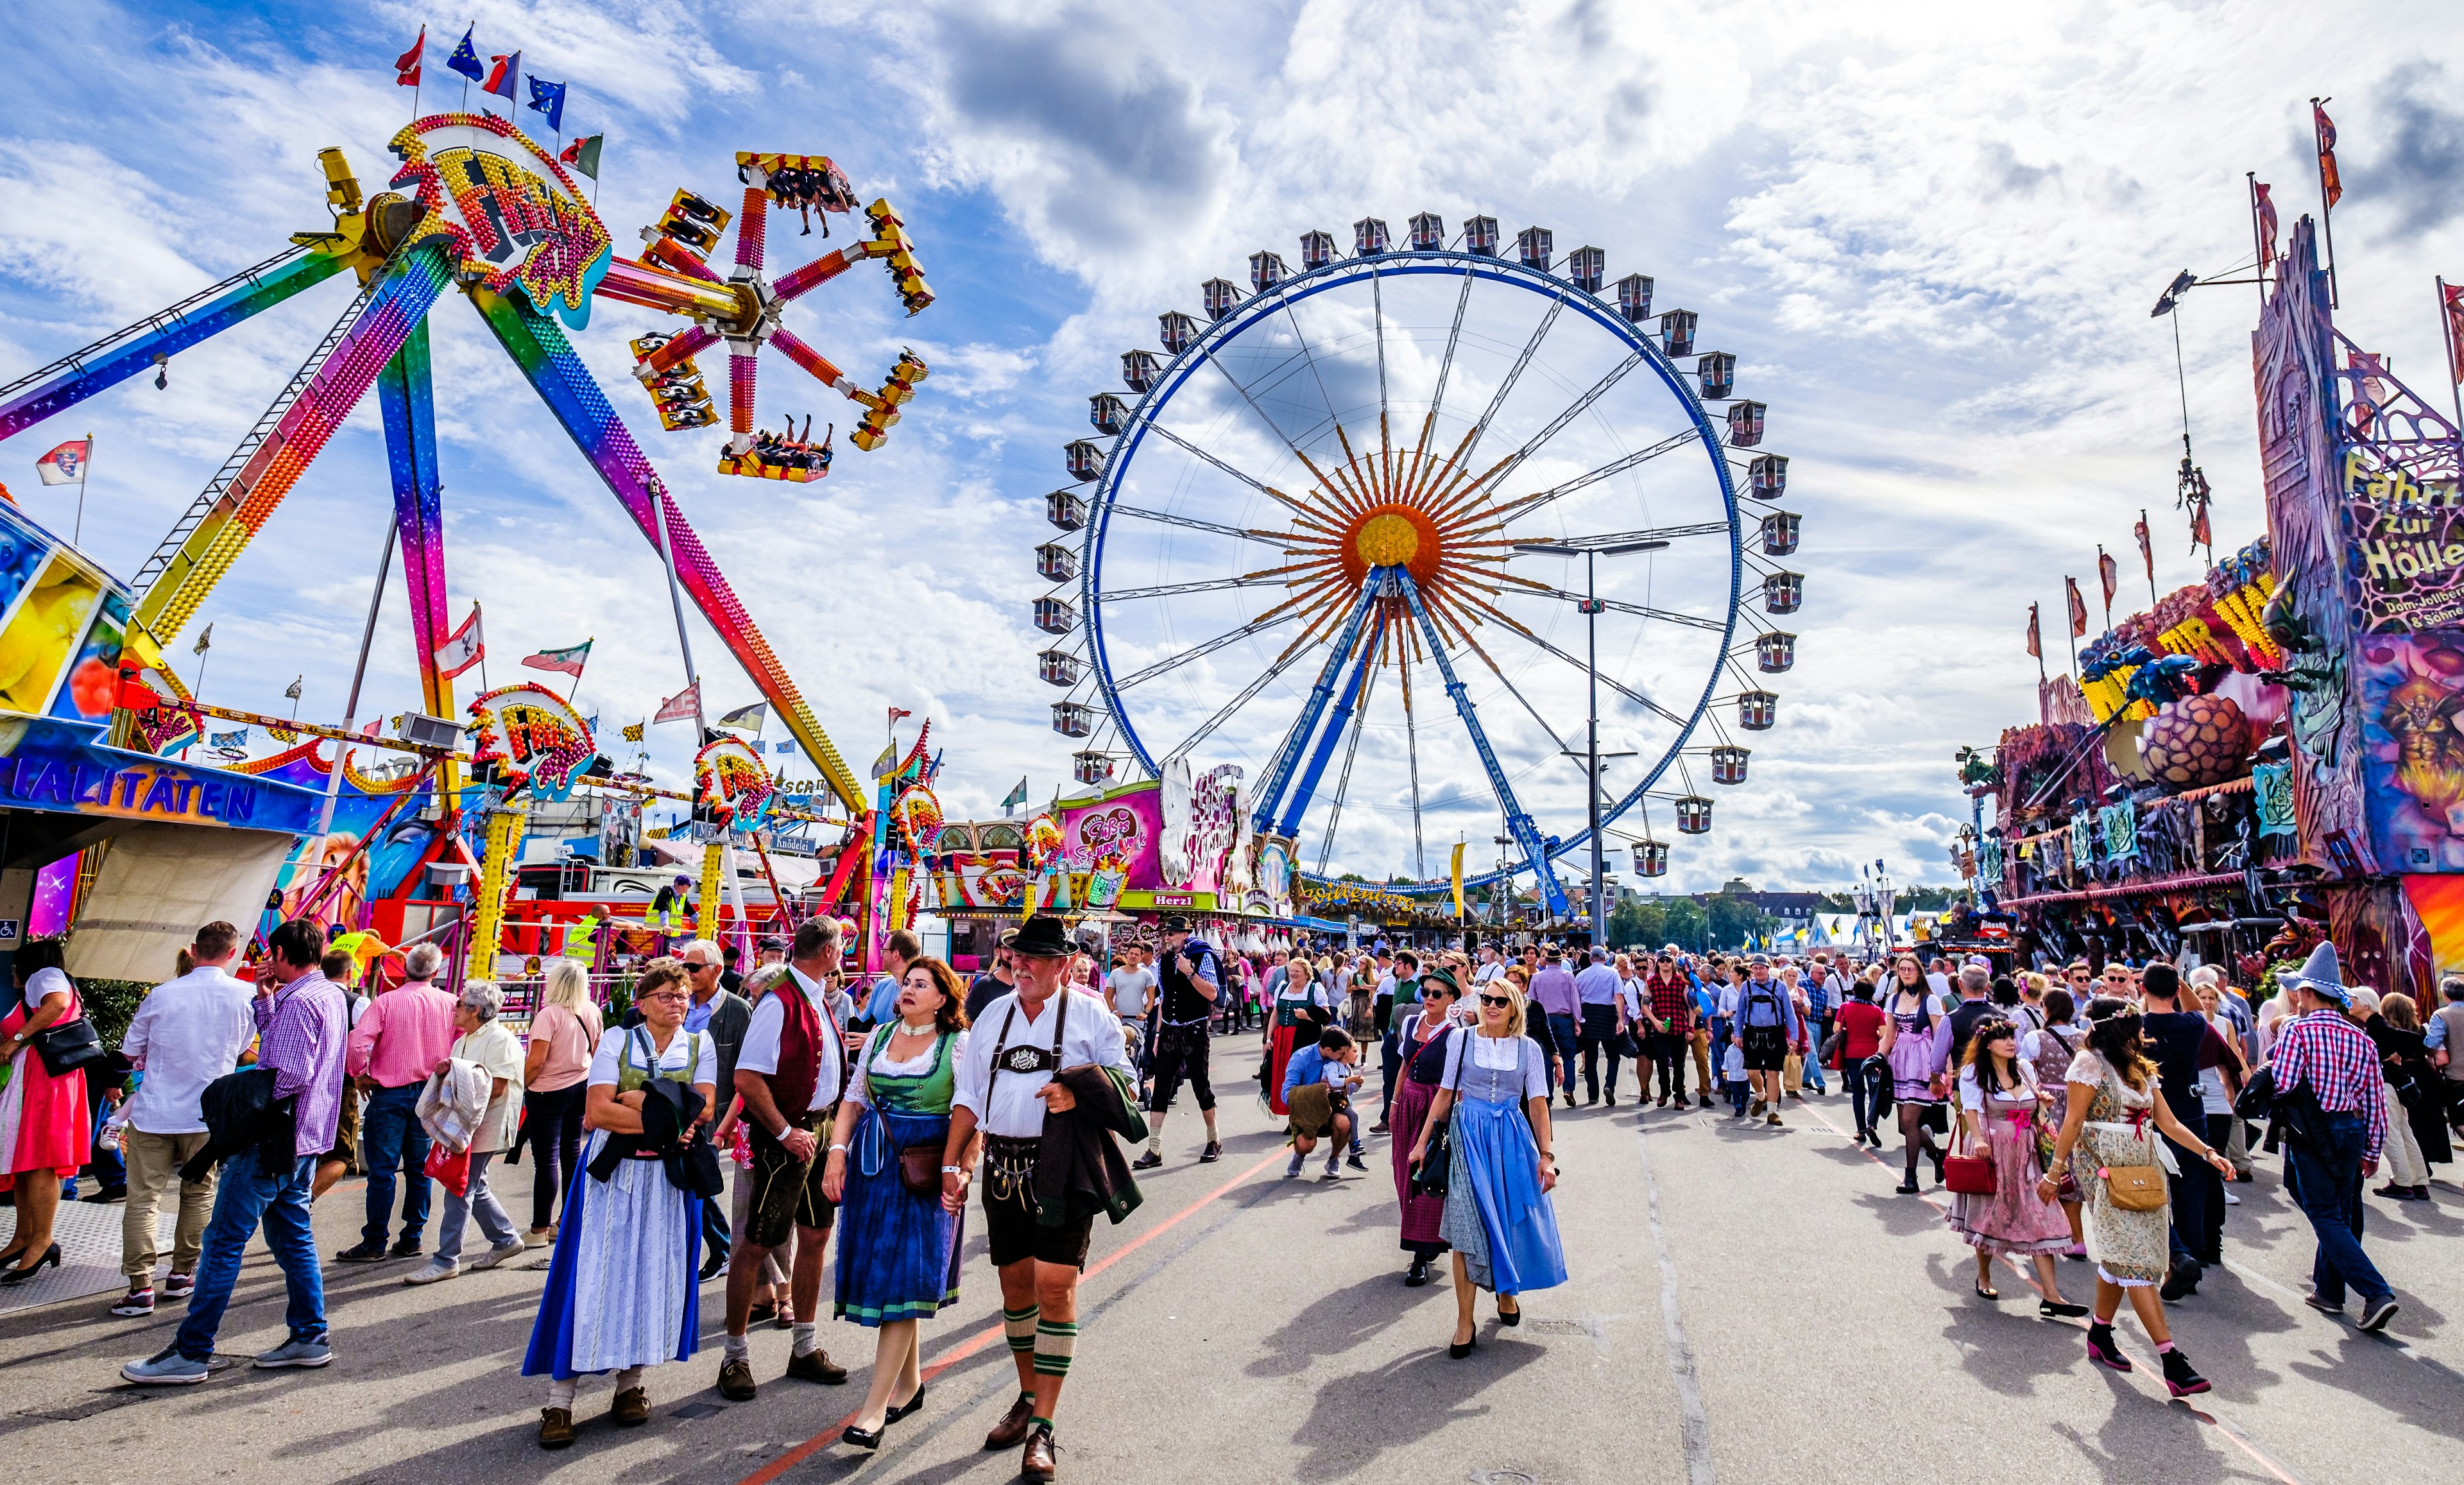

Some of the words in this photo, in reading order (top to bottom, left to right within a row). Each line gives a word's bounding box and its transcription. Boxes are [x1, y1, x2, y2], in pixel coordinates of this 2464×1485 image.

[2344, 451, 2463, 508] Fahrt
[2383, 514, 2434, 535] zur
[2358, 538, 2464, 579] Hölle
[2411, 616, 2423, 628] &
[2424, 606, 2463, 624] Söhne
[776, 836, 809, 852] Knödelei
[1156, 896, 1192, 906] Herzl
